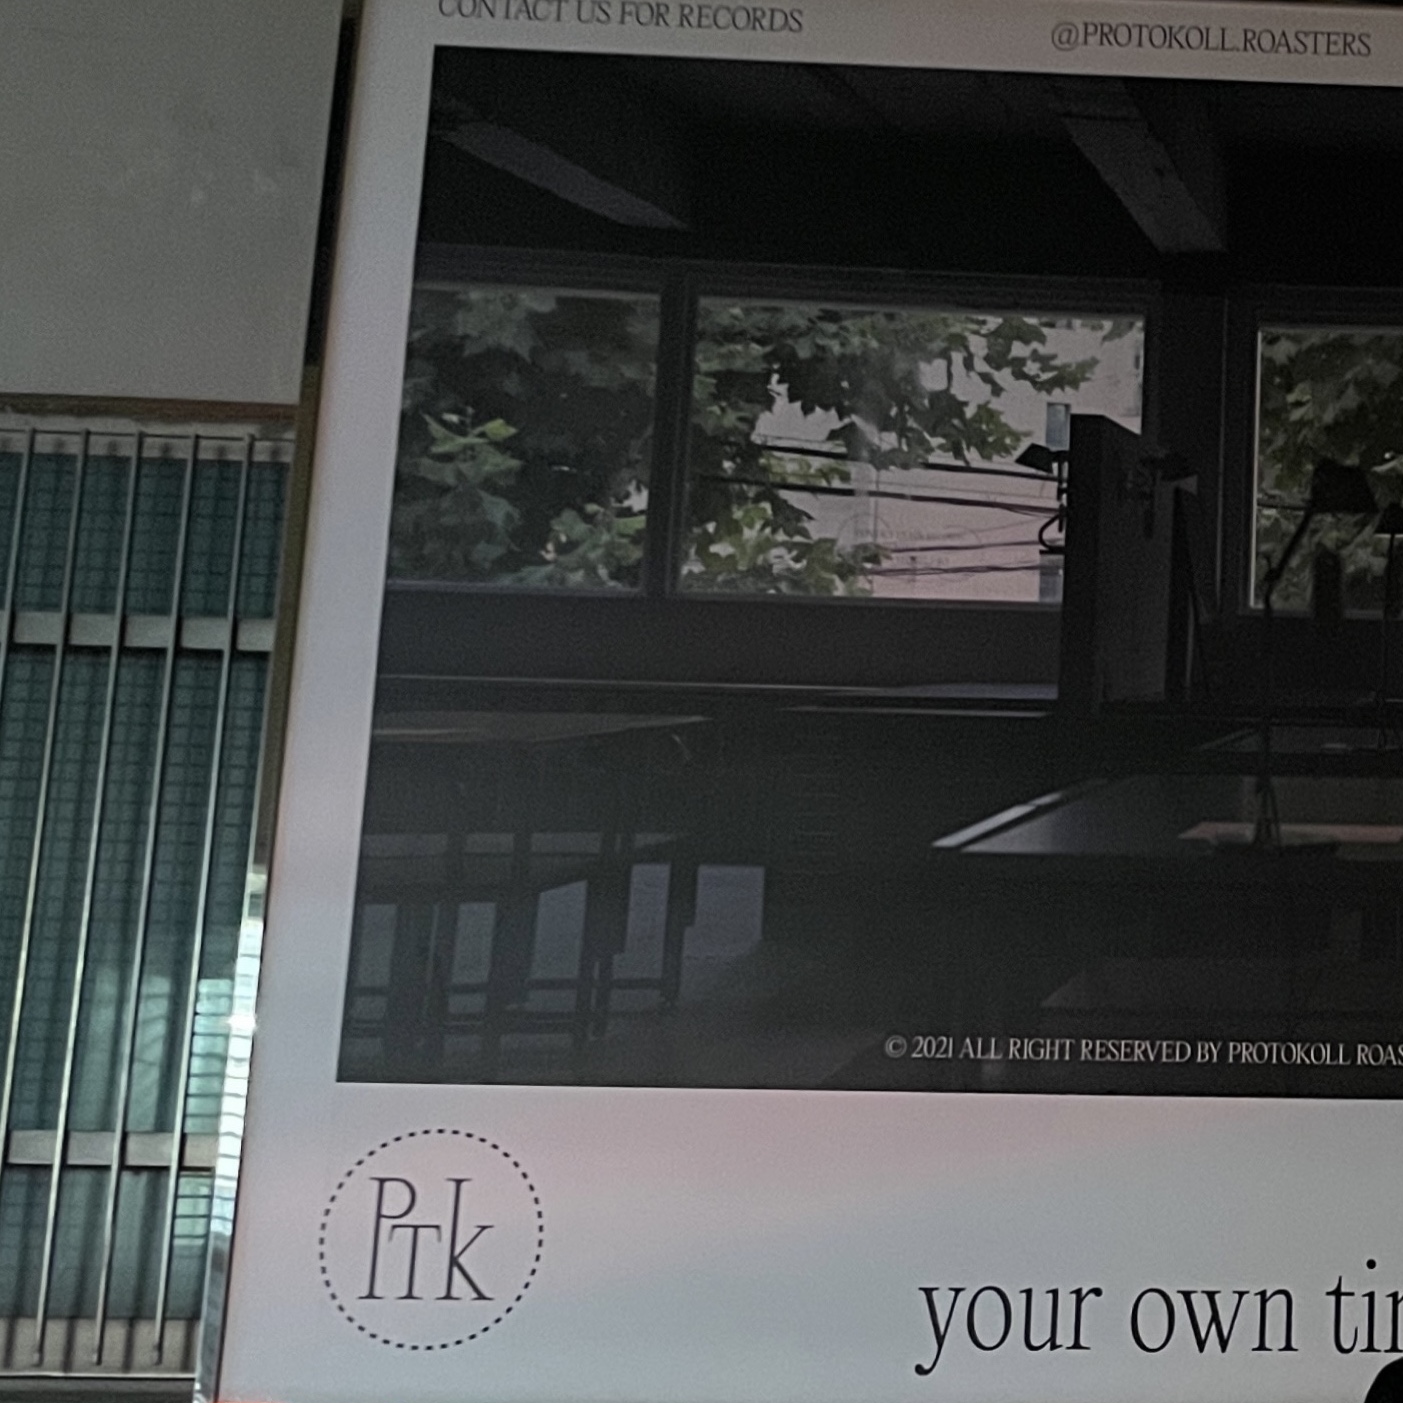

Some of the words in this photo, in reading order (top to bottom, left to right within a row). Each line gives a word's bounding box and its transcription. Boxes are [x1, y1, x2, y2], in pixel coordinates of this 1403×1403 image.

[438, 0, 566, 22] CONTACT
[576, 0, 612, 24] US
[619, 1, 670, 28] FOR
[678, 4, 804, 33] RECORDS
[911, 1035, 953, 1058] 2021
[958, 1037, 1002, 1060] ALL
[1008, 1038, 1076, 1061] RIGHT
[1080, 1039, 1192, 1063] RESERVED
[1196, 1041, 1223, 1063] BY
[1228, 1041, 1350, 1065] PROTOKOLL
[914, 1285, 1104, 1376] your
[1130, 1287, 1299, 1353] own
